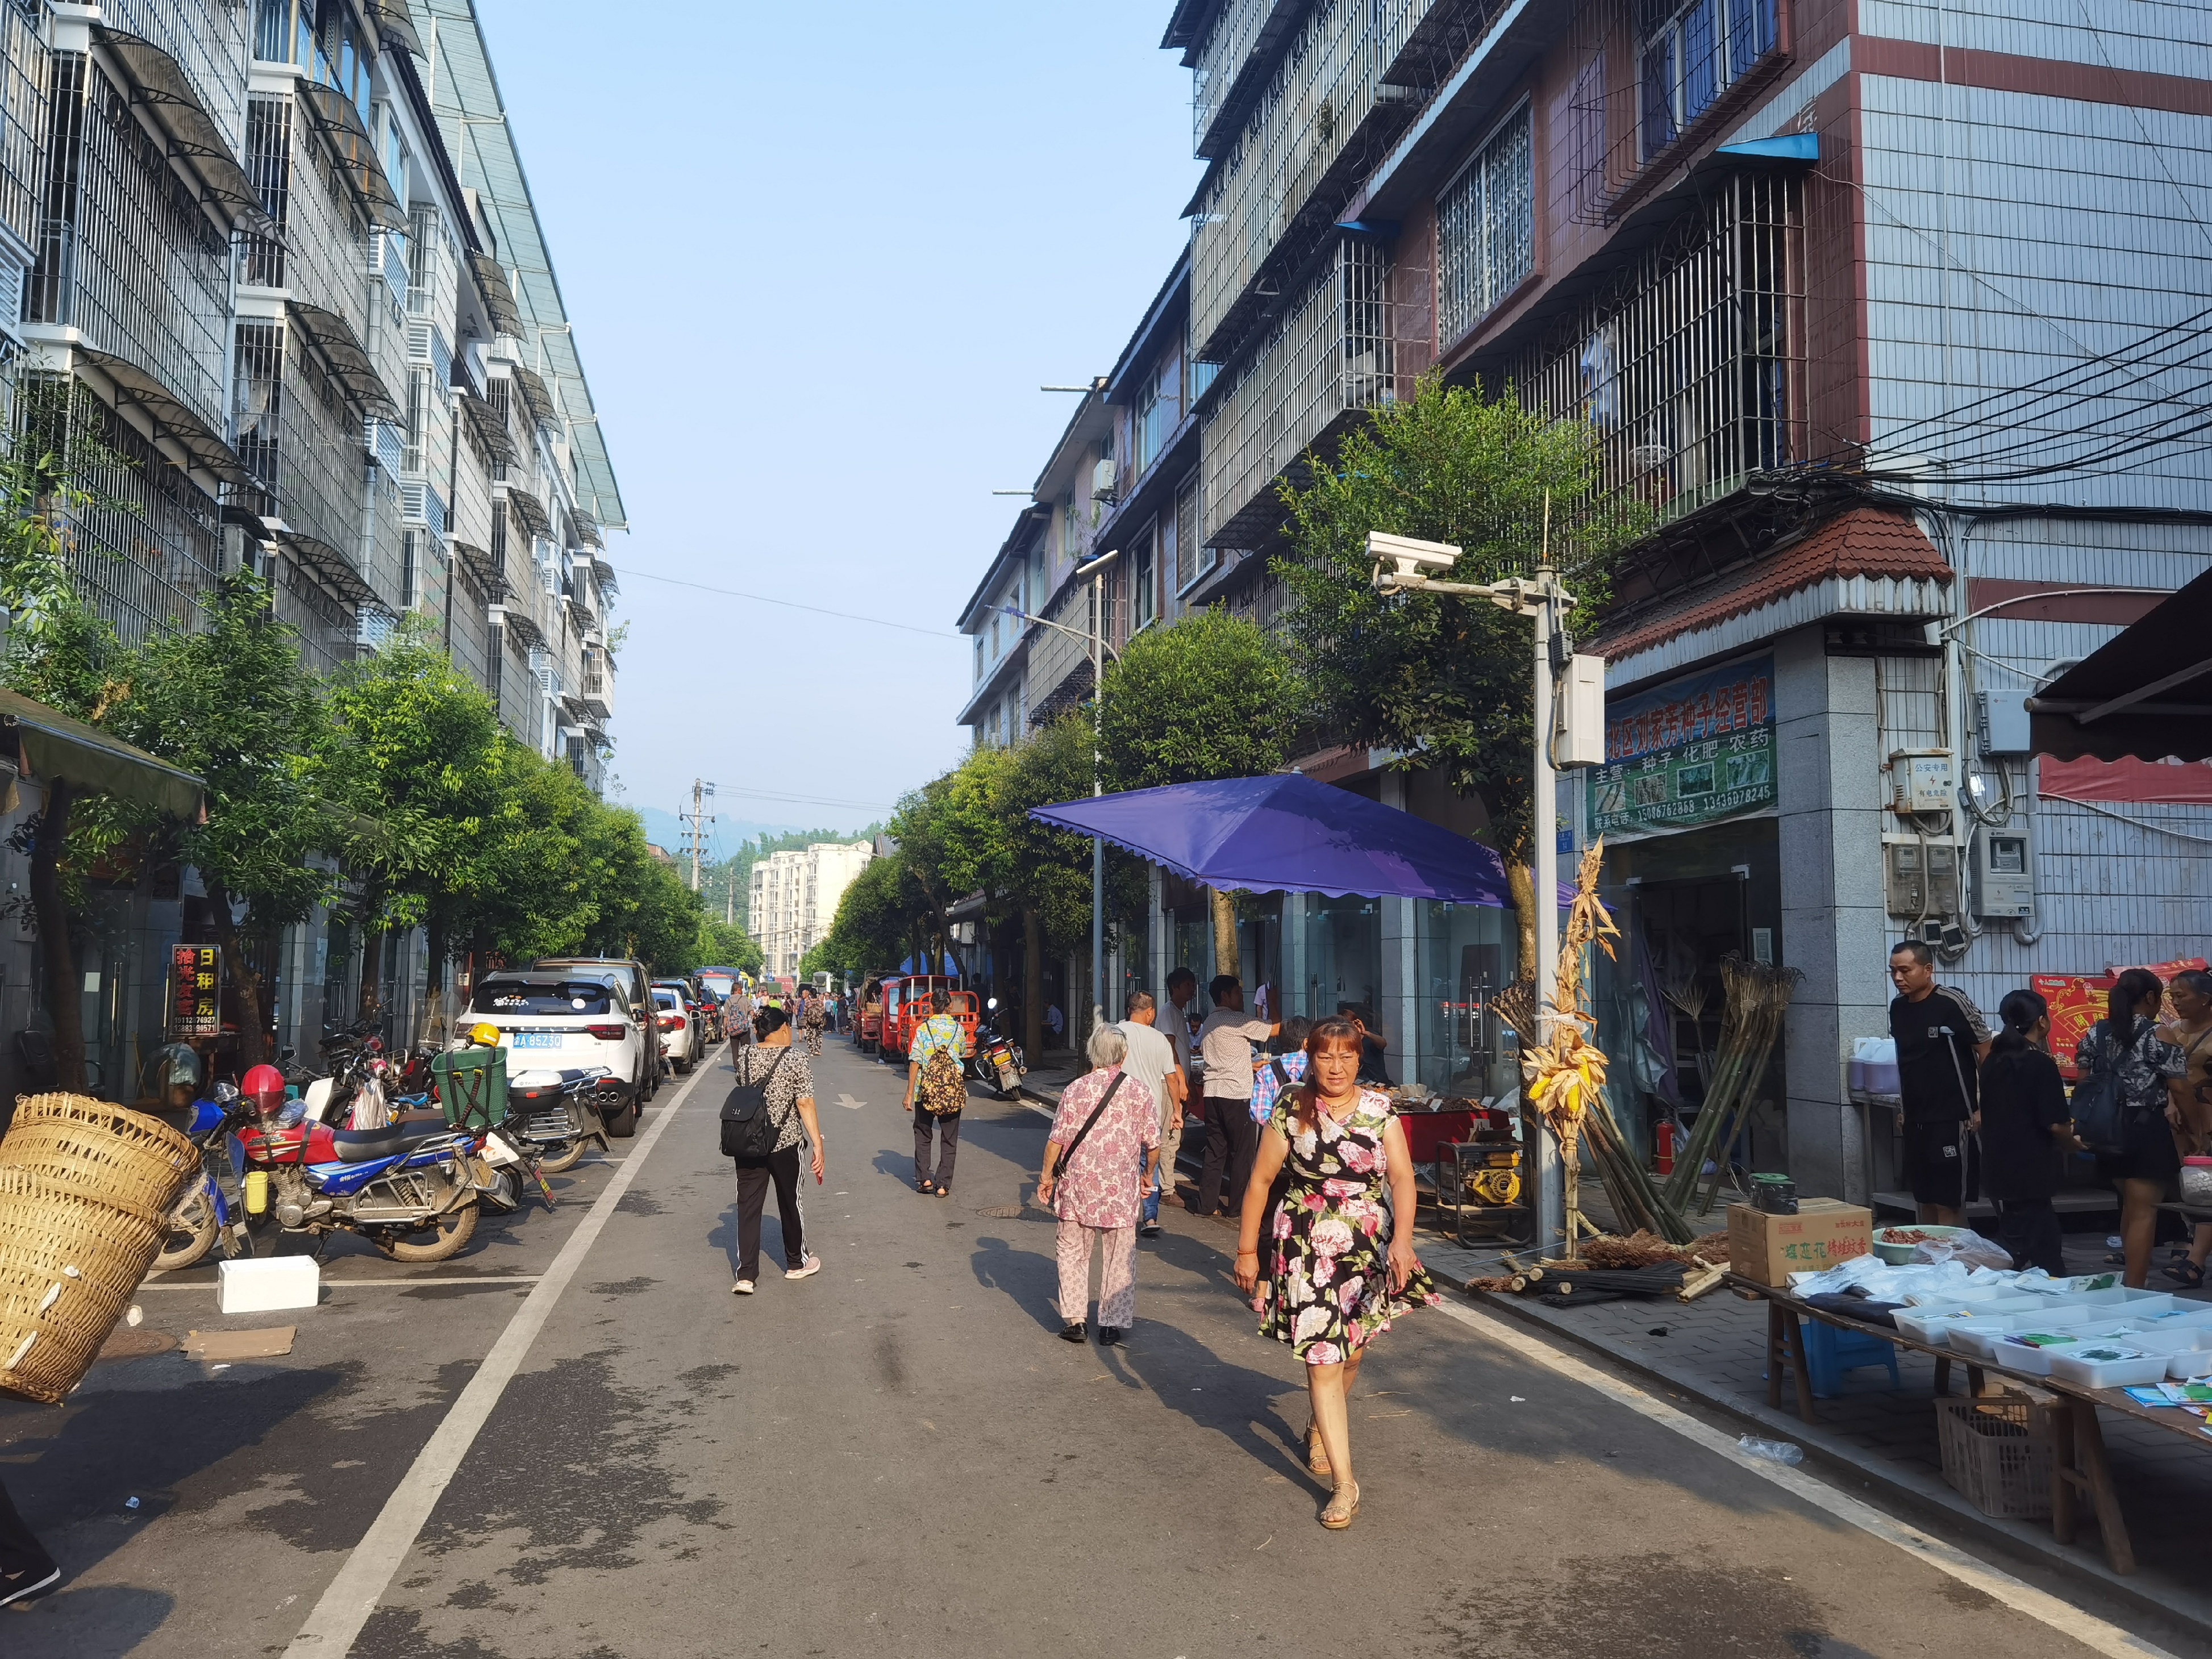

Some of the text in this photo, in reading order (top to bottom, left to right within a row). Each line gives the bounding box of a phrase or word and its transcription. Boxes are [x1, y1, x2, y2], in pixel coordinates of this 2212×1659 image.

[1642, 752, 1674, 774] 种子
[1682, 741, 1718, 765] 化肥
[1730, 728, 1769, 753] 农药
[1915, 763, 1948, 772] 公安专用
[196, 949, 215, 1015] 日租房
